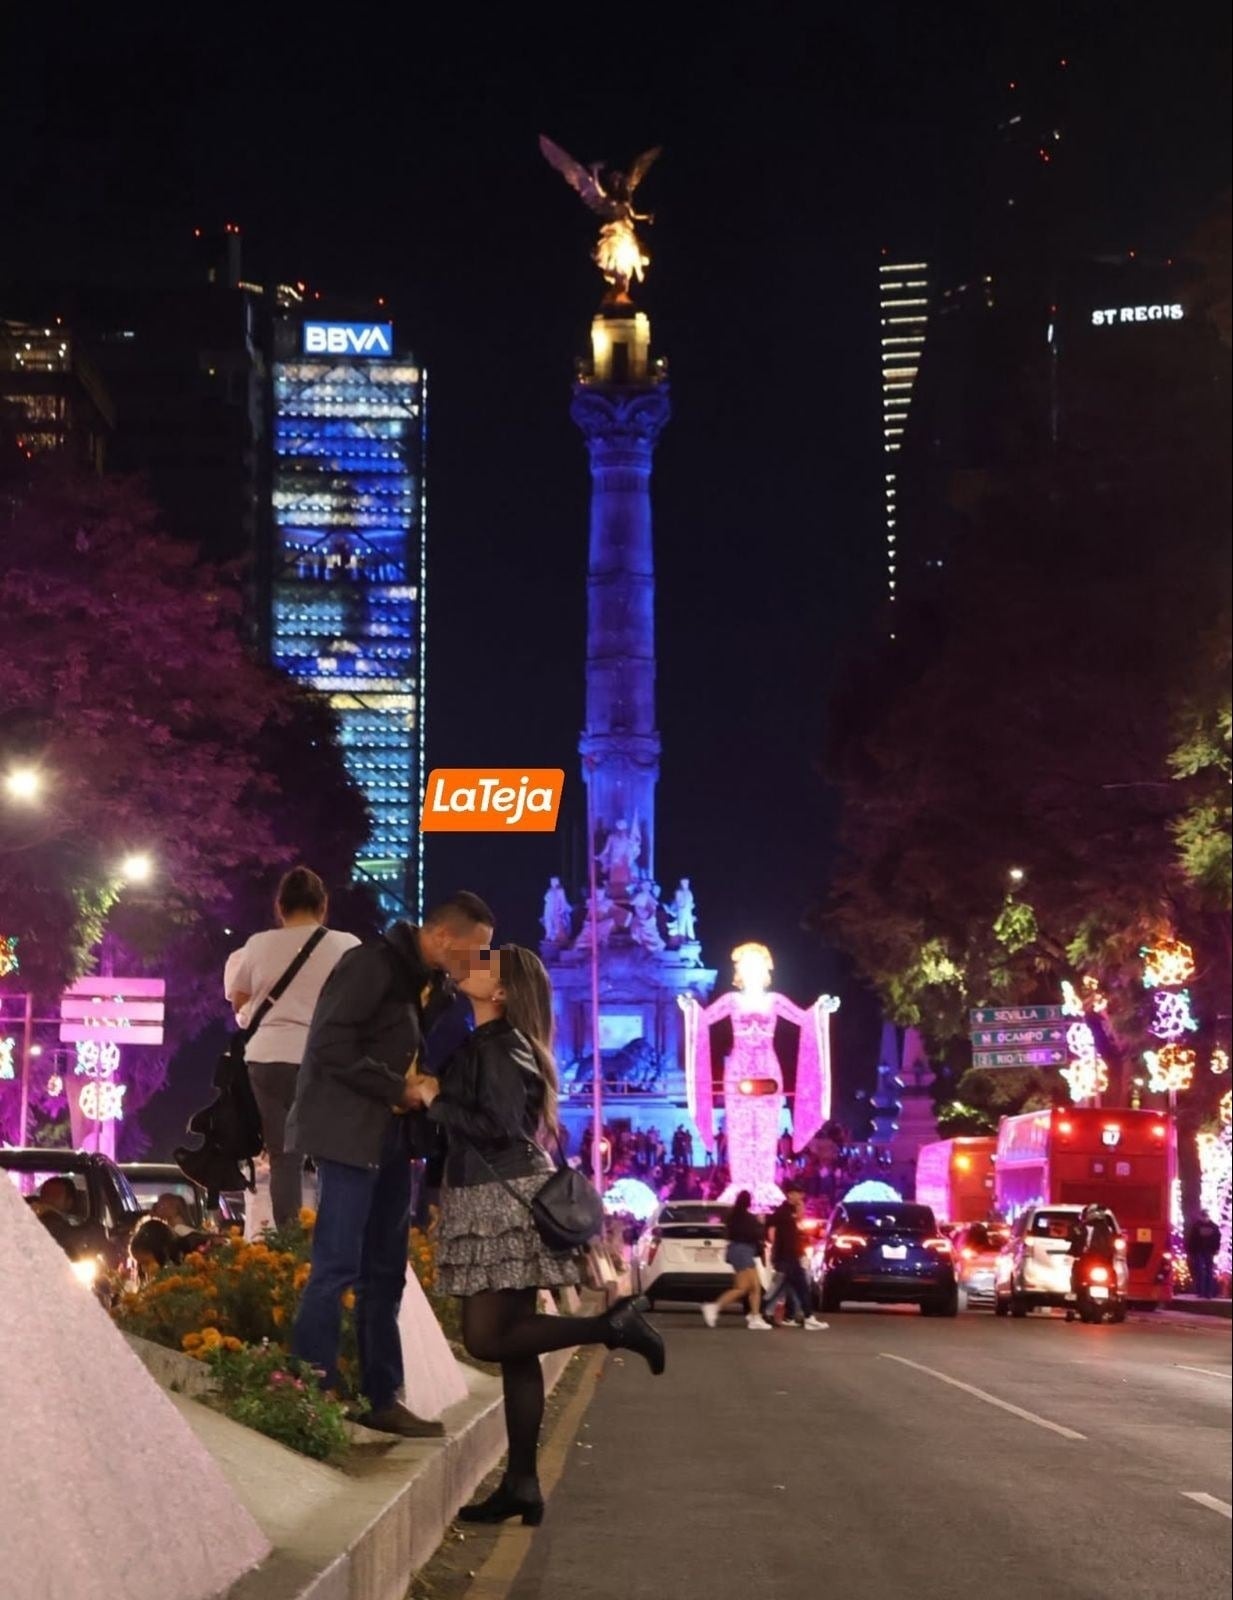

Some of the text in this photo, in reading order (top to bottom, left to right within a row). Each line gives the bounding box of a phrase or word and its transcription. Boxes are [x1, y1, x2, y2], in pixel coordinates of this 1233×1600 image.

[1092, 304, 1184, 325] ST REGIS
[306, 326, 389, 353] BBVA
[994, 1010, 1038, 1021] SEVILLA
[997, 1031, 1044, 1042] OCAMPO
